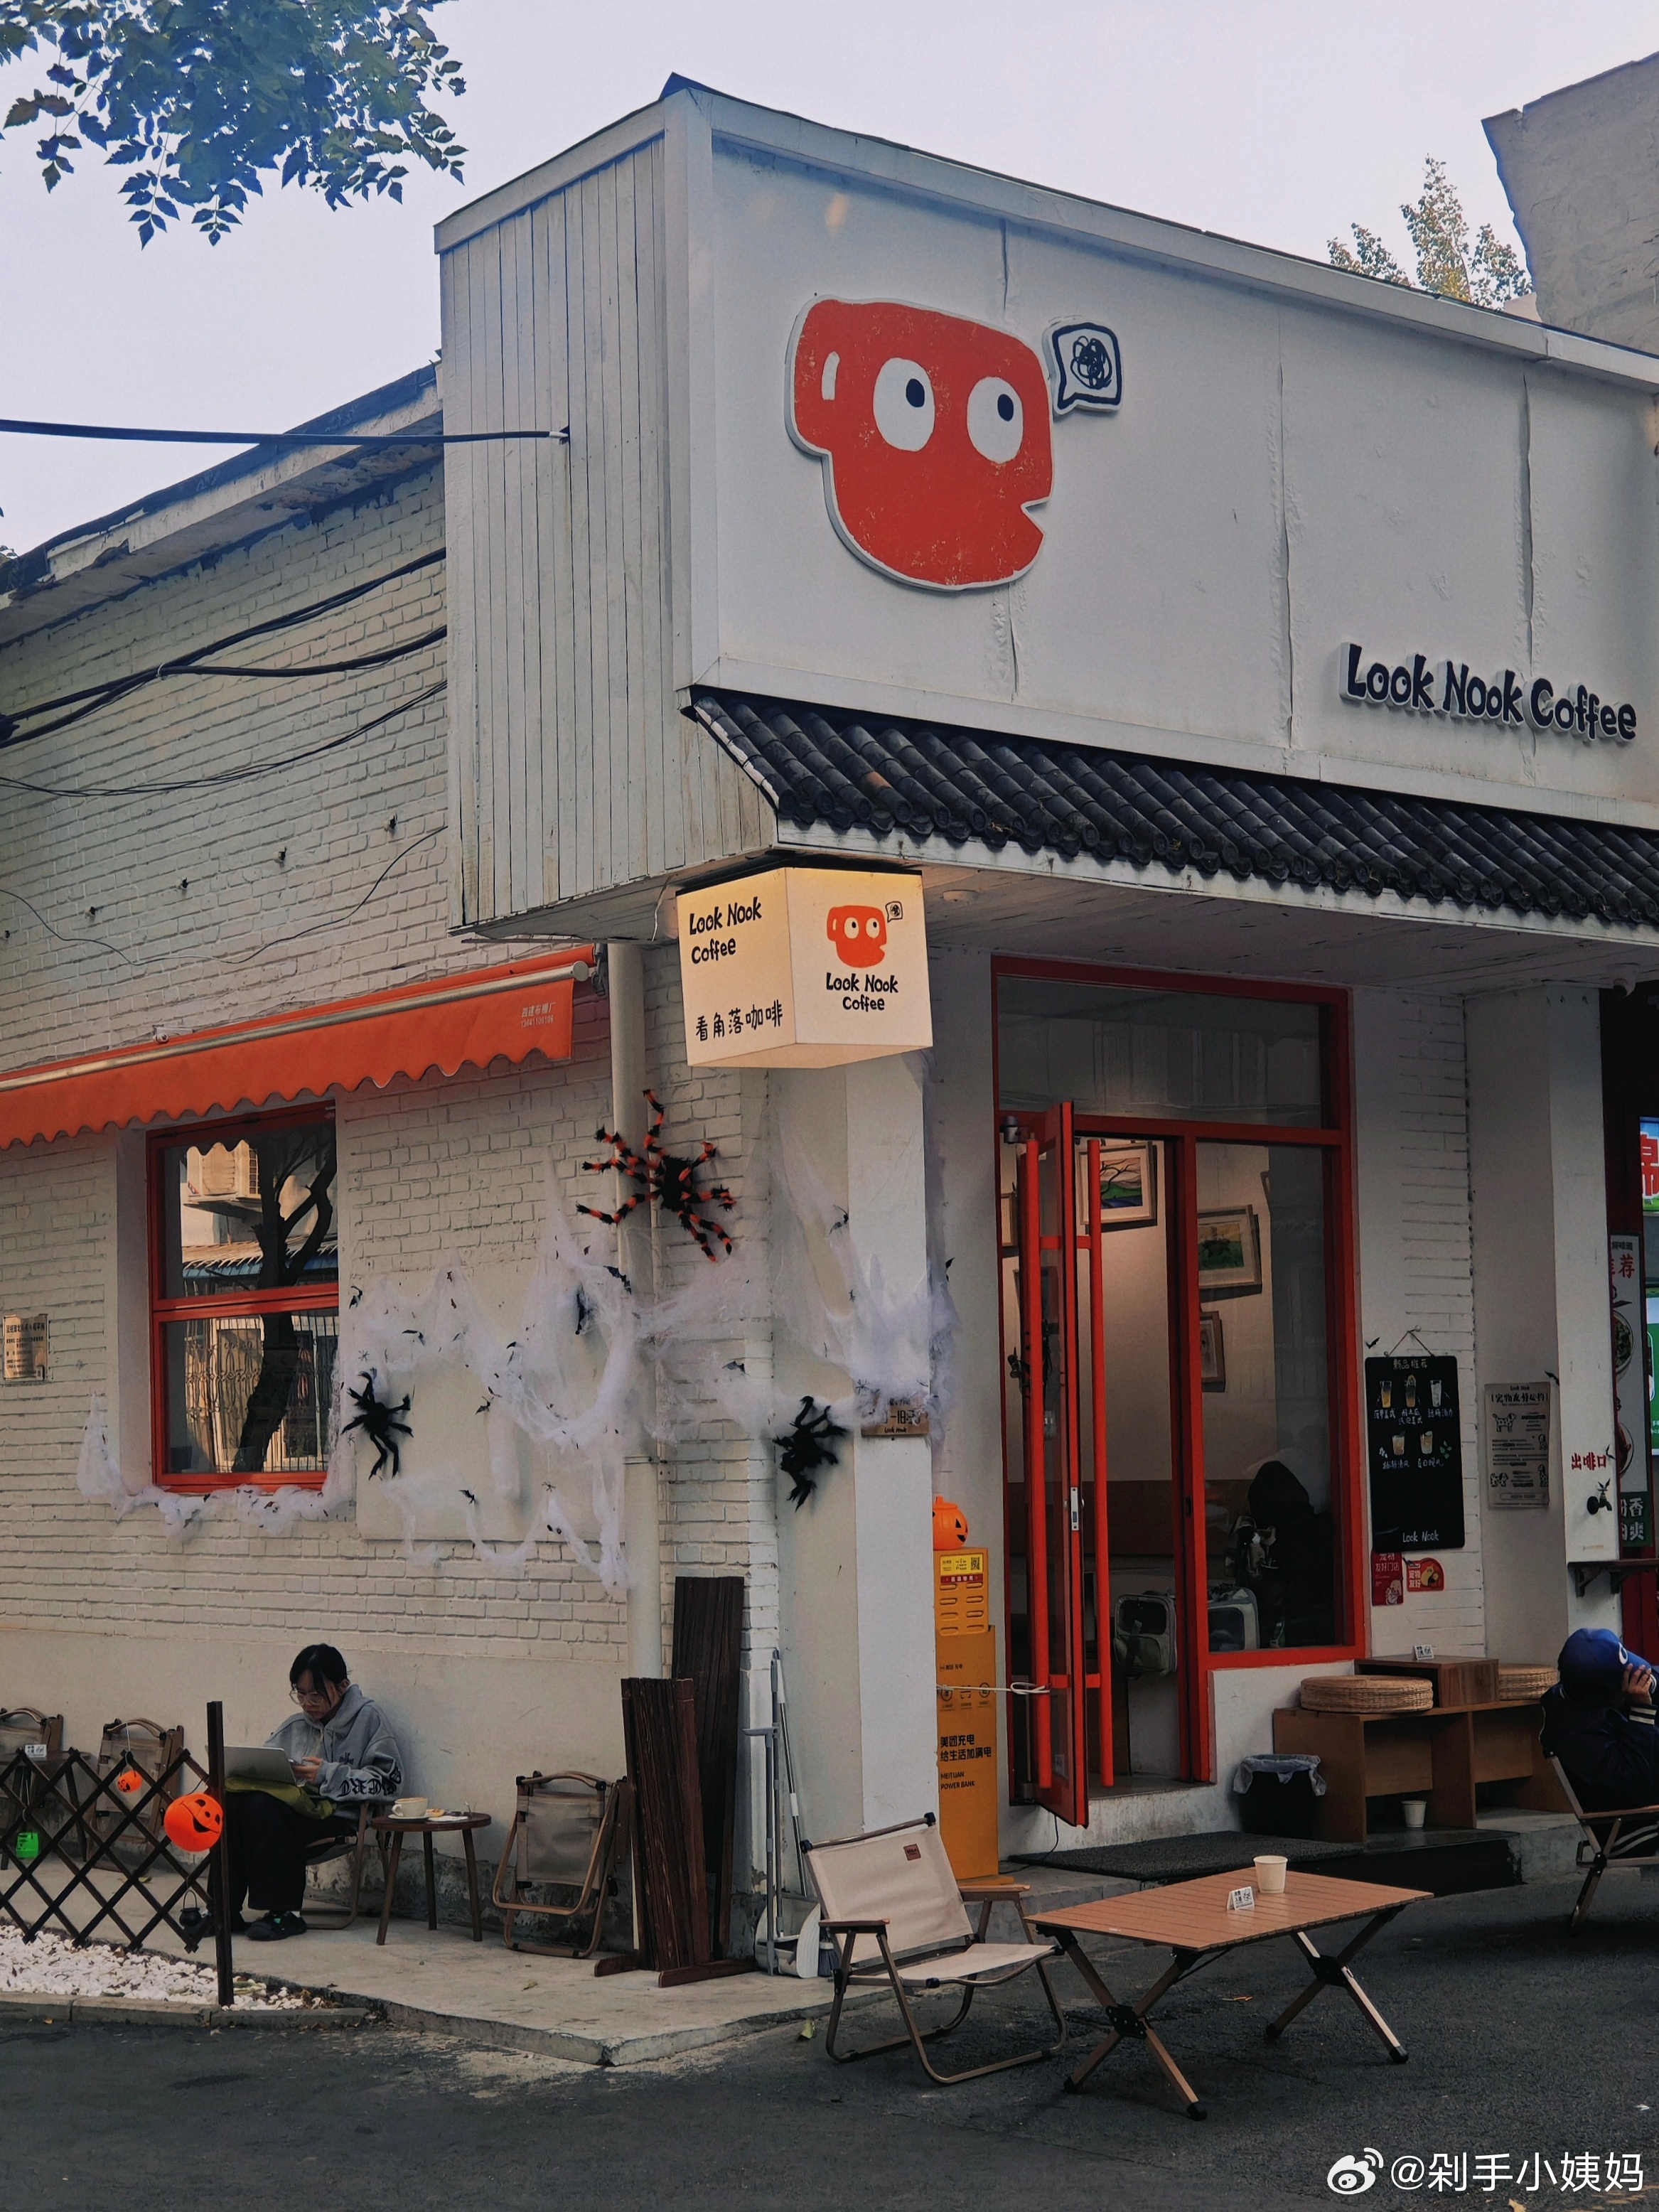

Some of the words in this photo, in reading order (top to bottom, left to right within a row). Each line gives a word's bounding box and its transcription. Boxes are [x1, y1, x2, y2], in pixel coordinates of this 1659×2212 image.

[1343, 643, 1434, 710] Look
[1440, 660, 1524, 726] Nook
[1530, 677, 1637, 741] Coffee
[689, 906, 723, 935] Look
[726, 896, 763, 928] Nook
[691, 938, 736, 965] Coffee
[826, 972, 859, 992] Look
[864, 974, 899, 993] Nook
[842, 994, 885, 1012] Coffee
[695, 999, 783, 1041] 看角落咖啡
[1571, 1451, 1606, 1471] 出啡口
[1402, 1530, 1419, 1543] Look
[1422, 1529, 1439, 1542] Nook
[1375, 1562, 1400, 1572] 友好门店
[940, 1734, 975, 1748] 美团充电
[940, 1746, 992, 1762] 给生活加满电
[940, 1771, 965, 1780] MEITUAN
[940, 1781, 960, 1790] POWER
[961, 1780, 975, 1788] BANK
